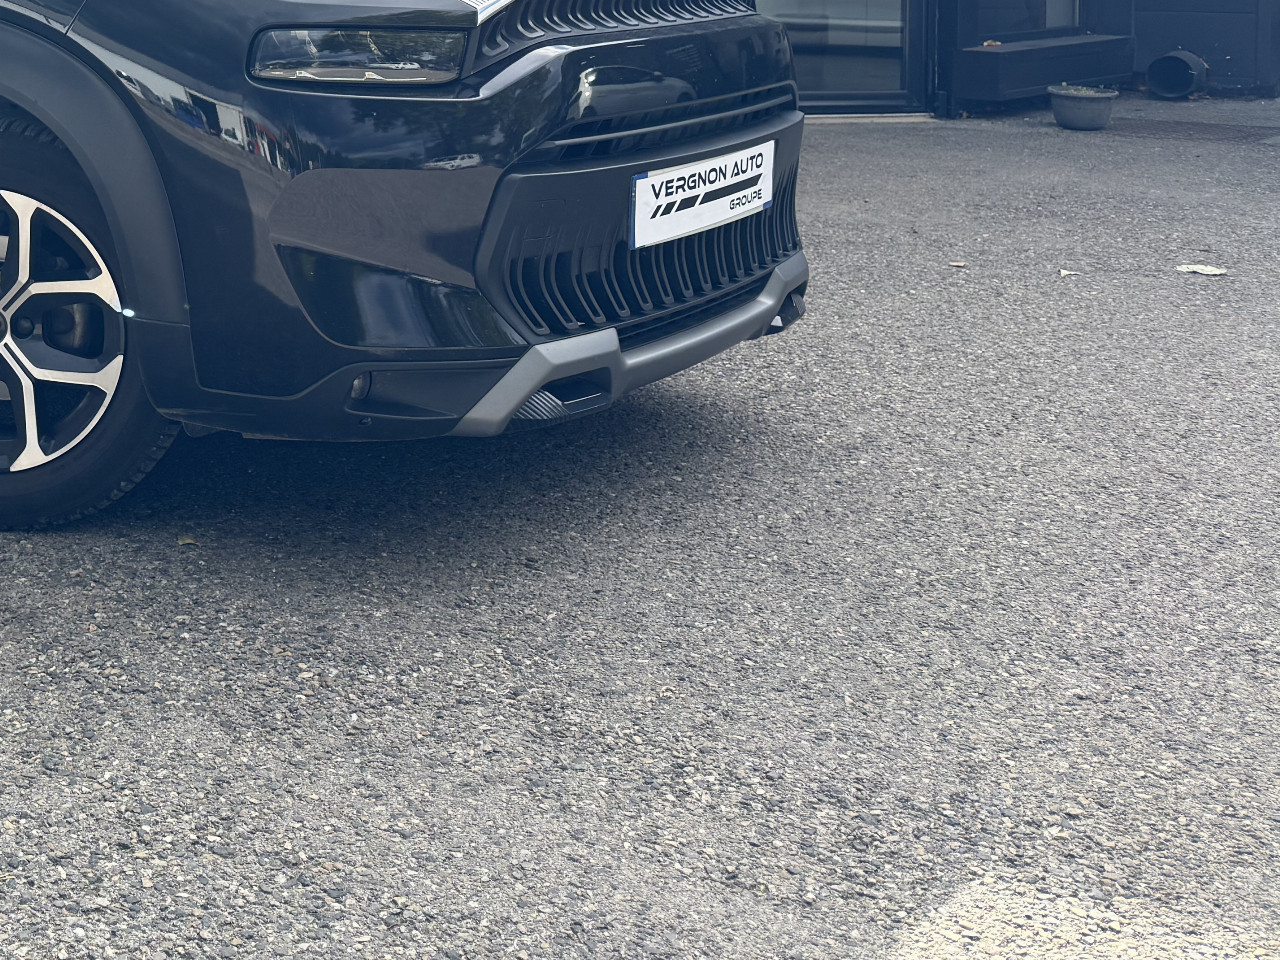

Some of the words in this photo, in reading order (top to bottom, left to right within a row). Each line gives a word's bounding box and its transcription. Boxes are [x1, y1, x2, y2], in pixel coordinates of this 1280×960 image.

[651, 164, 727, 200] VERGNON
[730, 152, 764, 179] AUTO
[729, 189, 763, 210] GROUPE
